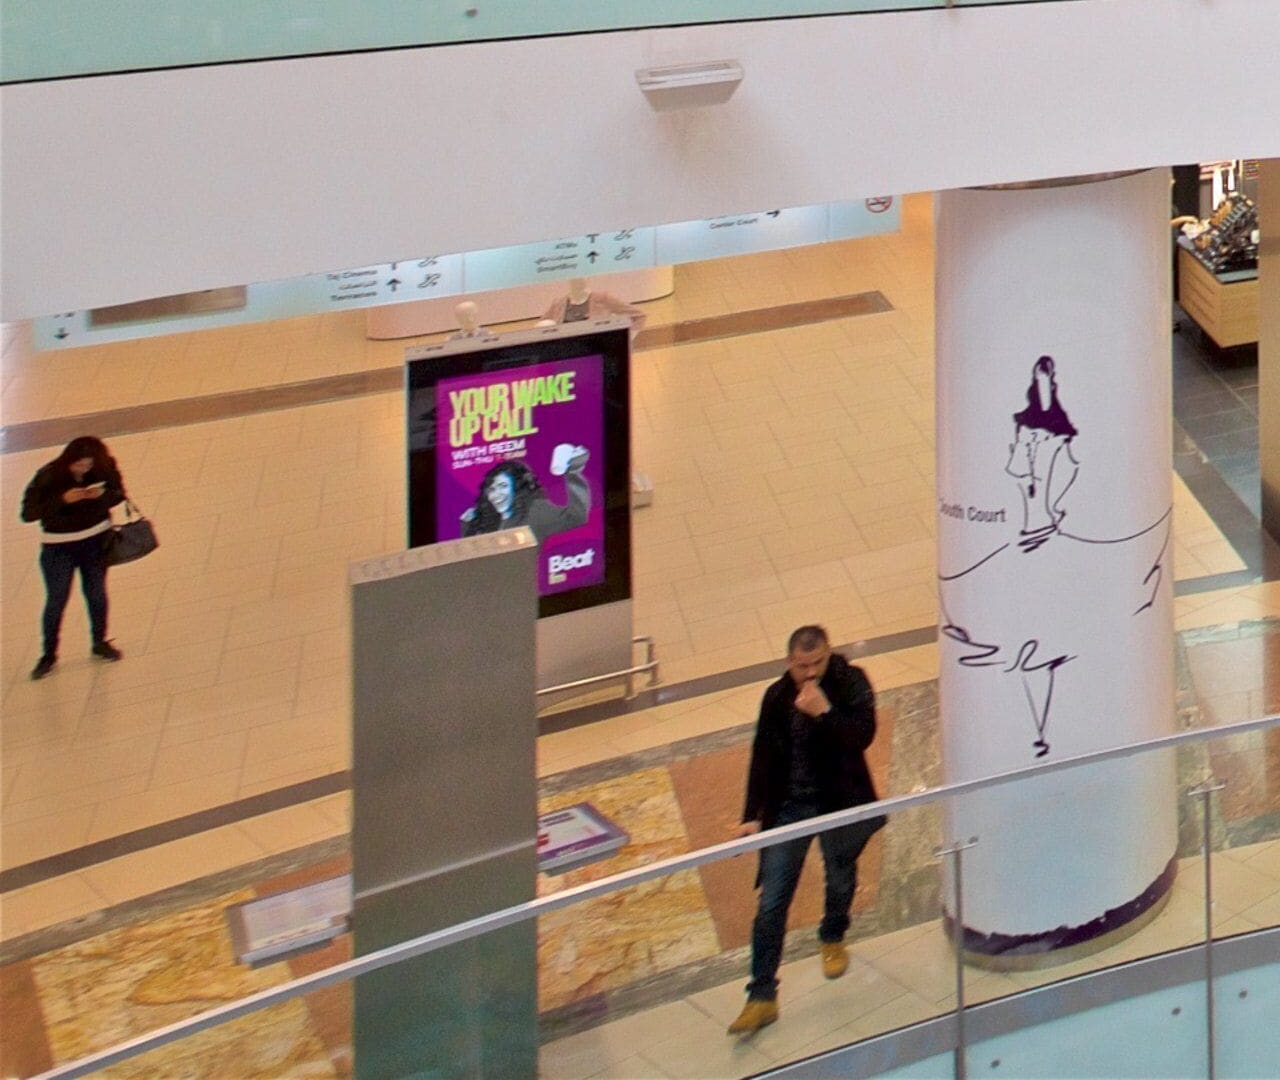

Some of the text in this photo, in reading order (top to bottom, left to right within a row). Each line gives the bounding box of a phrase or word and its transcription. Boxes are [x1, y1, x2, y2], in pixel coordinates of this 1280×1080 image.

[449, 371, 576, 419] YOUR WAKE
[449, 405, 539, 448] UP CALL
[451, 445, 488, 461] WITH
[488, 438, 526, 455] REEM
[966, 505, 1006, 523] Court
[548, 548, 596, 574] Beat
